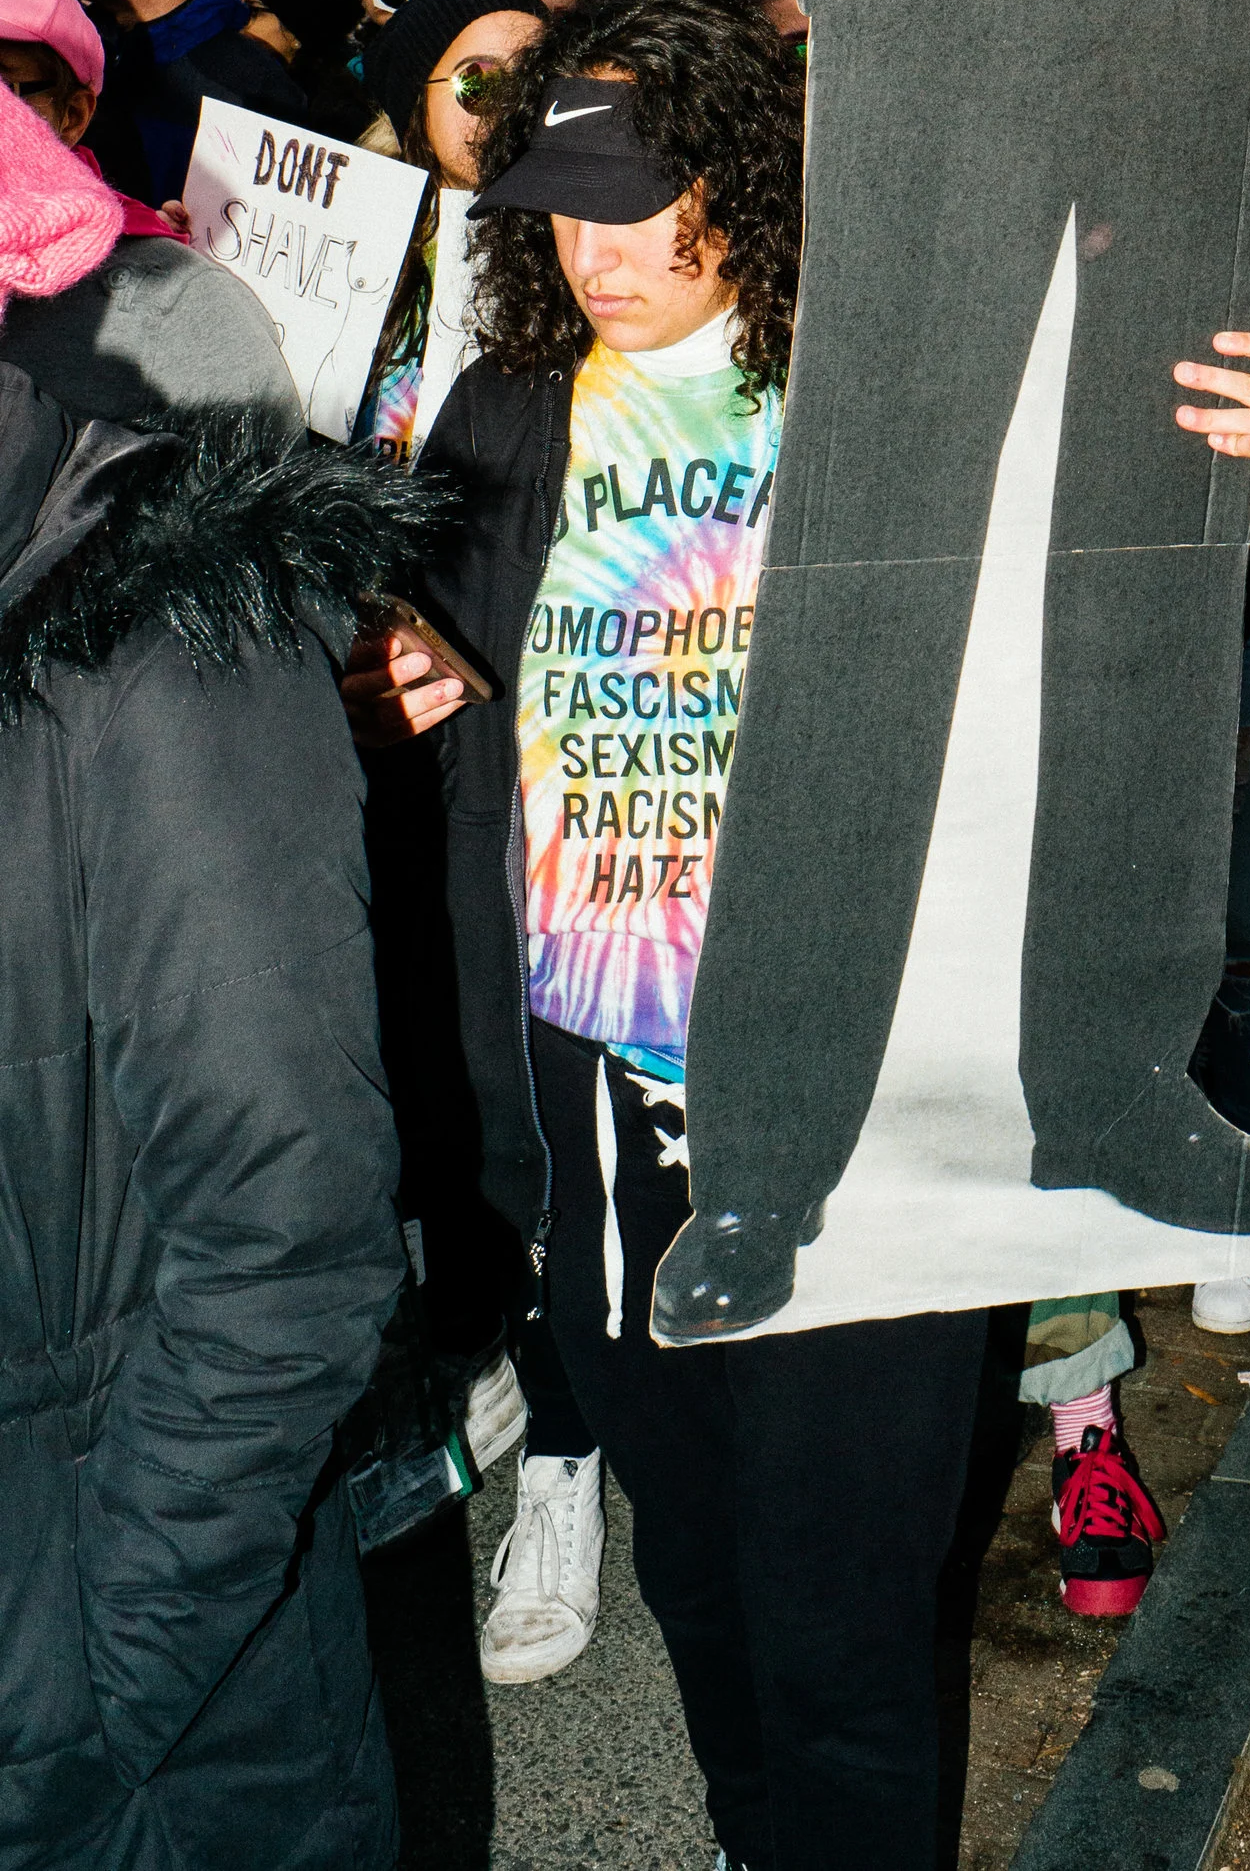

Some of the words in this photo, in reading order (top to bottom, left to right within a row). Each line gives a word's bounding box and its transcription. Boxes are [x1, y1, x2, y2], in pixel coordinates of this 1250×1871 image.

[253, 129, 350, 209] DONT
[206, 197, 345, 309] SHAVE
[526, 604, 755, 658] OMOPHOB
[558, 729, 736, 780] SEXISM
[588, 851, 704, 904] HATE
